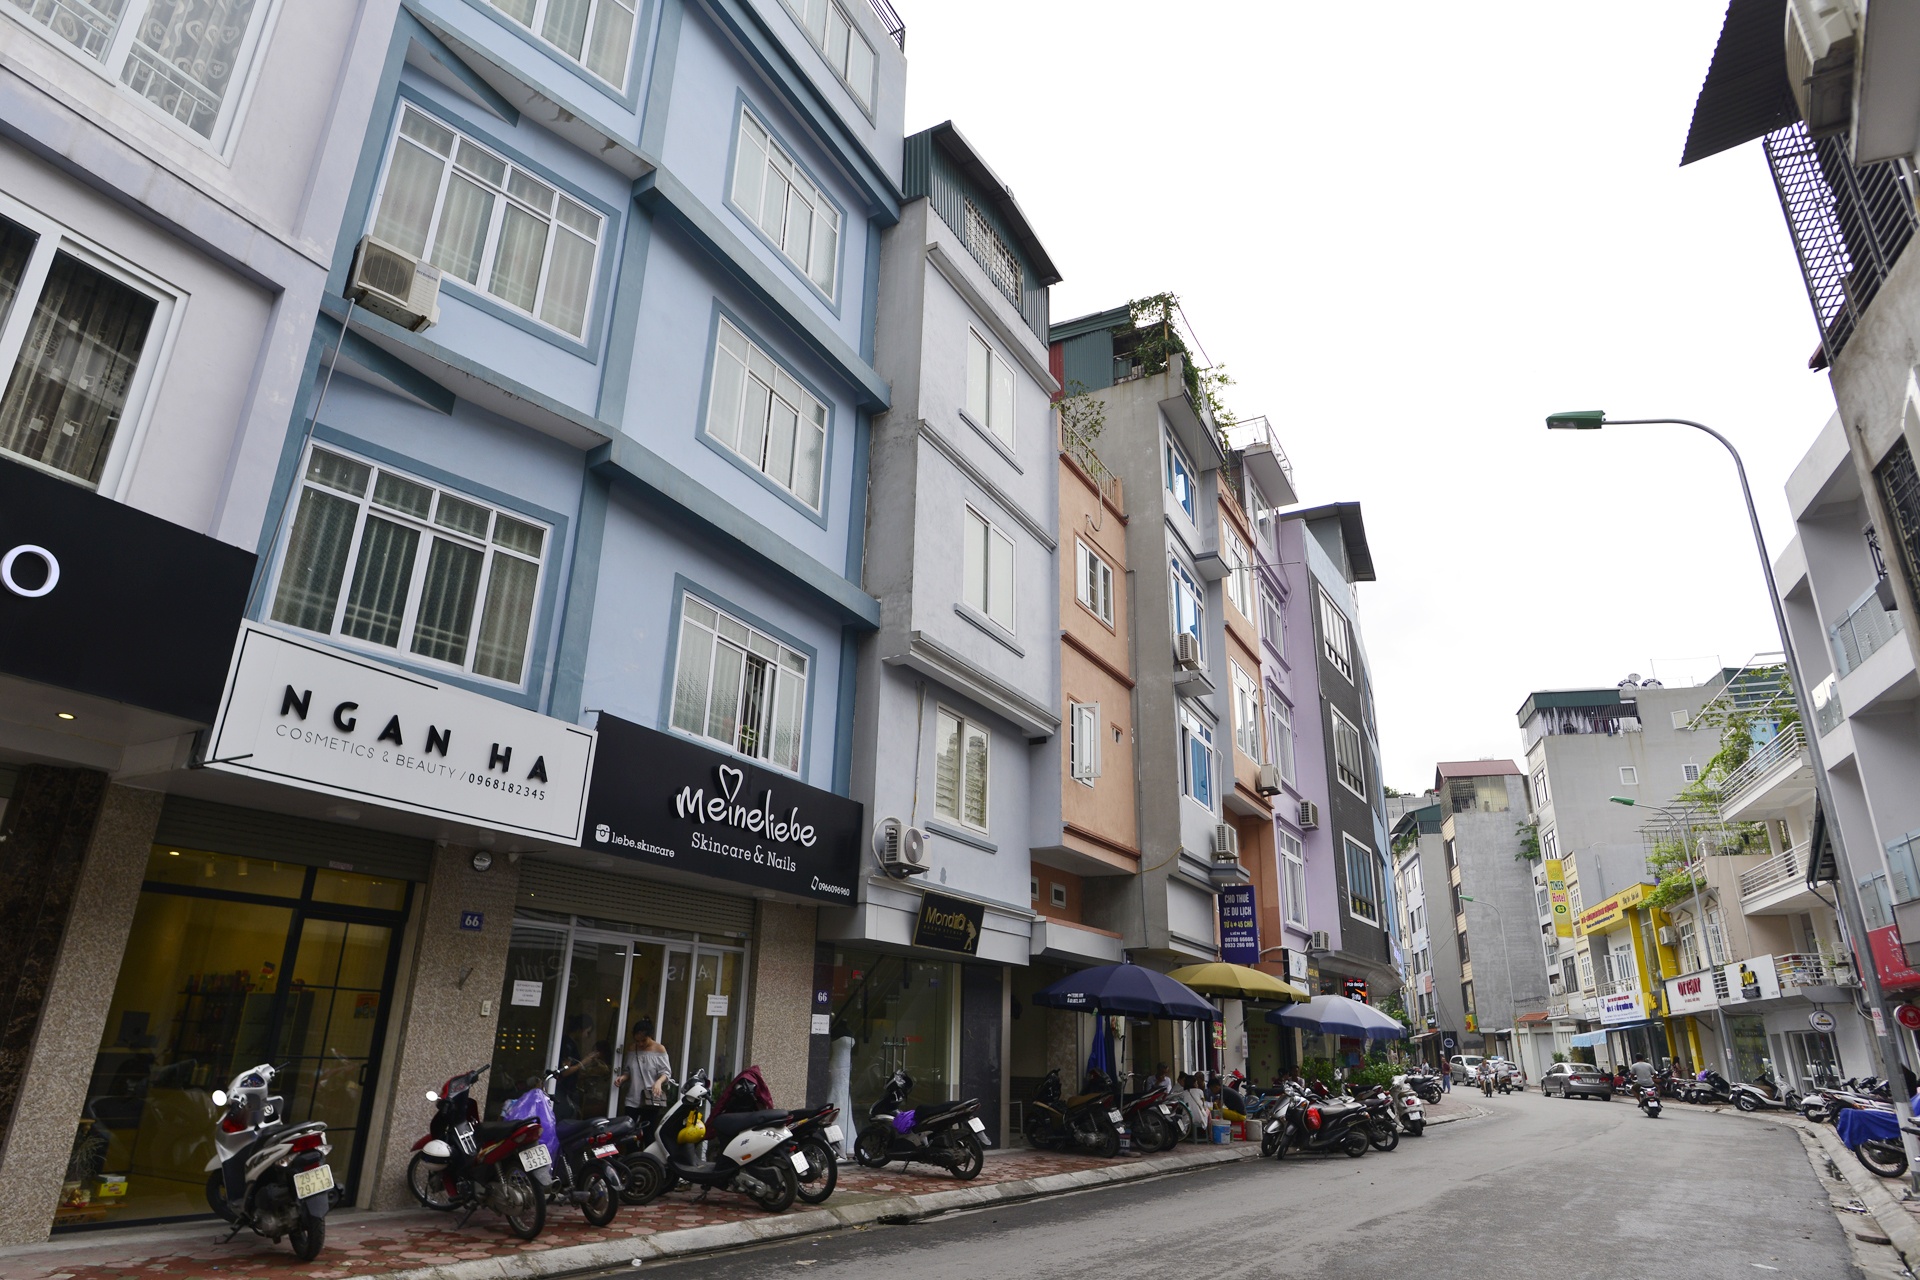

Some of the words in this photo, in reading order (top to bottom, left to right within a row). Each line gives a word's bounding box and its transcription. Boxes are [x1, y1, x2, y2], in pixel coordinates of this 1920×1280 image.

[280, 684, 451, 757] NGAN
[488, 742, 548, 783] HA
[275, 724, 375, 760] COSMETICS
[395, 753, 457, 779] BEAUTY
[468, 773, 545, 801] 0968182345
[676, 784, 817, 848] Meineliebe
[691, 831, 752, 860] Skincare
[753, 844, 764, 864] &
[766, 850, 797, 872] Nails
[1224, 894, 1236, 904] CHO
[1551, 892, 1567, 903] Hotel
[1223, 907, 1231, 917] XE
[1231, 906, 1239, 917] DU
[465, 915, 480, 927] 66
[817, 991, 828, 1002] 66
